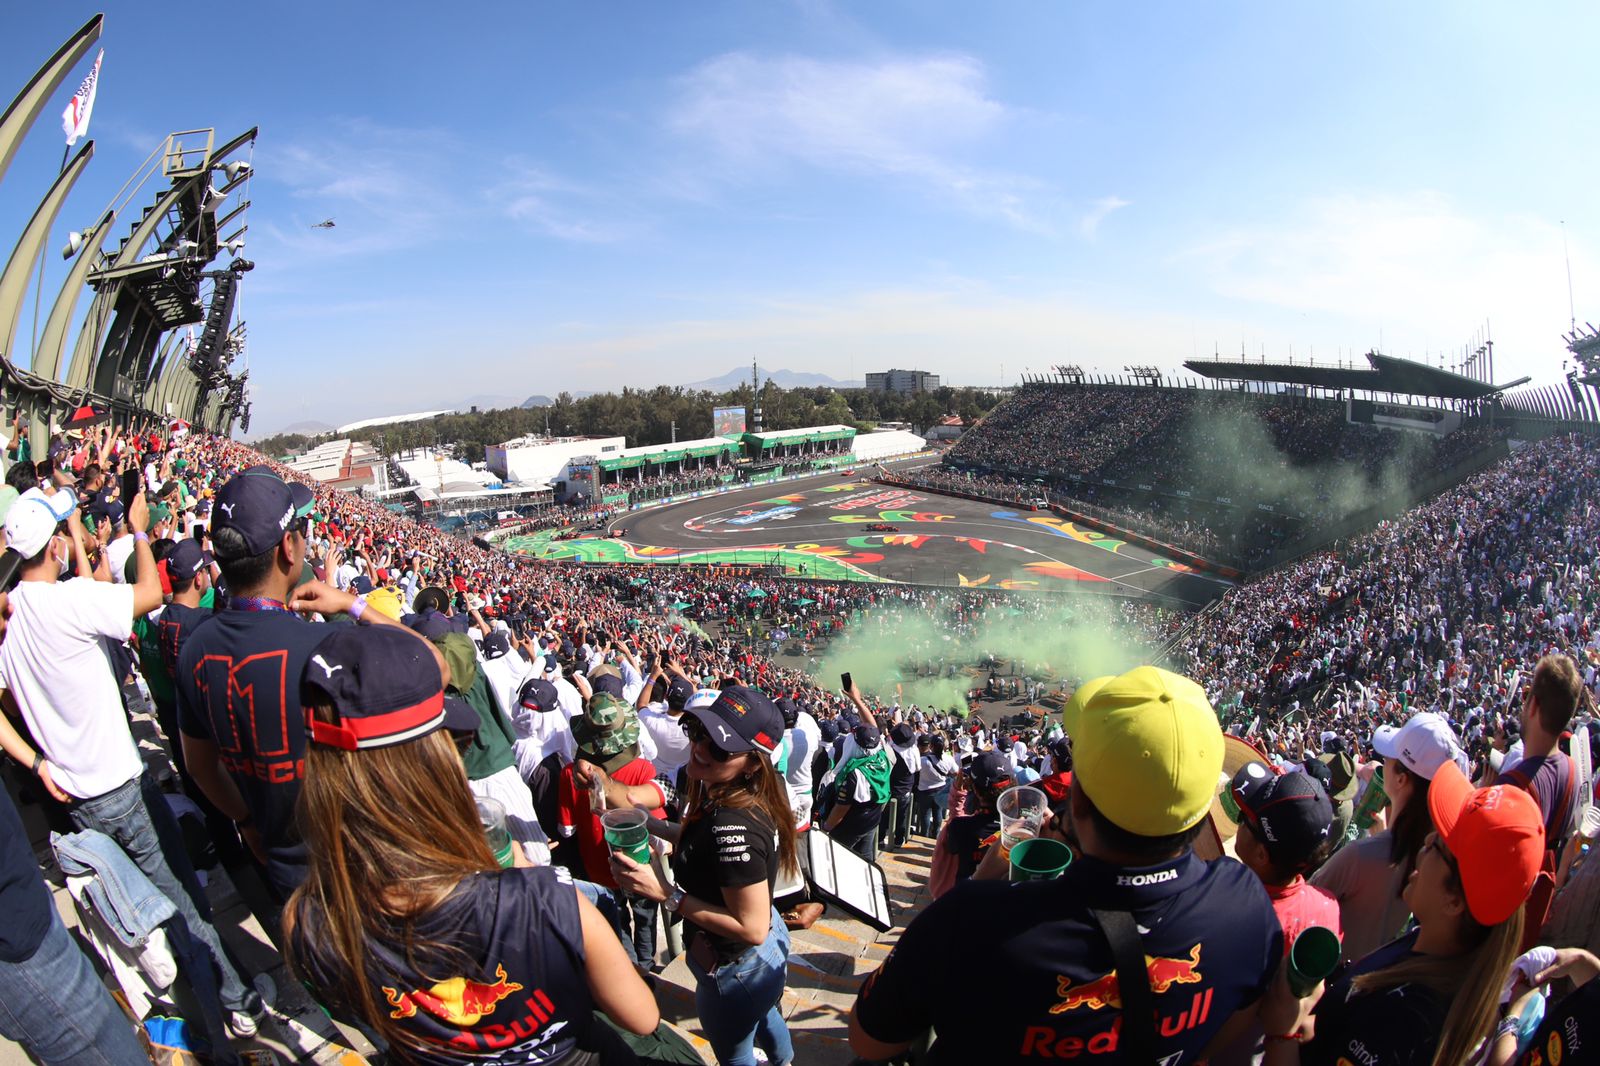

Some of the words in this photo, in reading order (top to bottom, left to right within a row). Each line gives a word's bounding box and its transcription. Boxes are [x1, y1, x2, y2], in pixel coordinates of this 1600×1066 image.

[1138, 483, 1152, 491] RACE
[1258, 503, 1274, 512] RACE
[193, 649, 289, 757] 11
[716, 834, 746, 845] EPSON
[1261, 816, 1278, 842] telcel
[1116, 868, 1179, 886] HONDA
[482, 988, 556, 1050] Bull
[1020, 1015, 1123, 1059] Red
[1154, 988, 1214, 1037] ull
[1564, 1016, 1582, 1055] citrix
[1348, 1039, 1378, 1066] citrix
